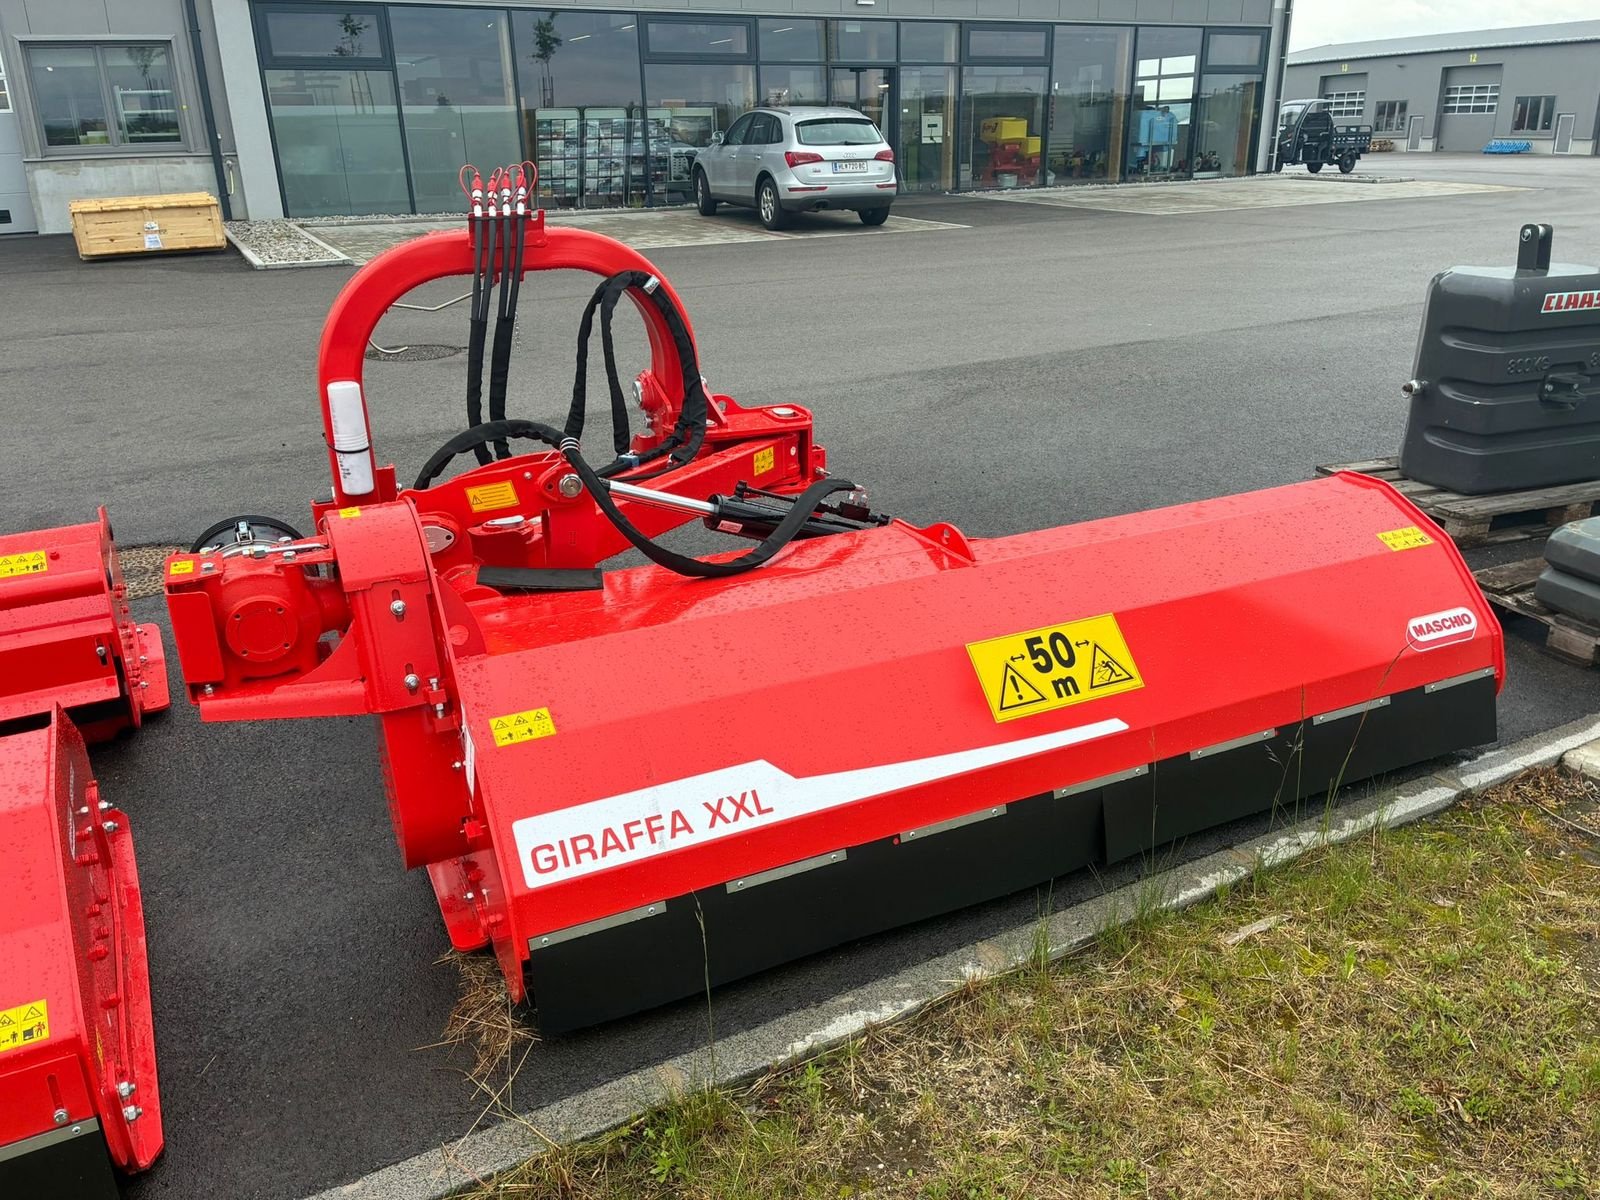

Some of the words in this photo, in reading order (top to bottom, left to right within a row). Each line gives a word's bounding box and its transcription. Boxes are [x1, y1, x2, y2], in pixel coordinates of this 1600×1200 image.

[1412, 613, 1472, 637] MASCHIO
[1024, 631, 1076, 674] 50
[1051, 675, 1080, 699] m
[530, 809, 694, 875] GIRAFFA
[702, 788, 774, 830] XXL
